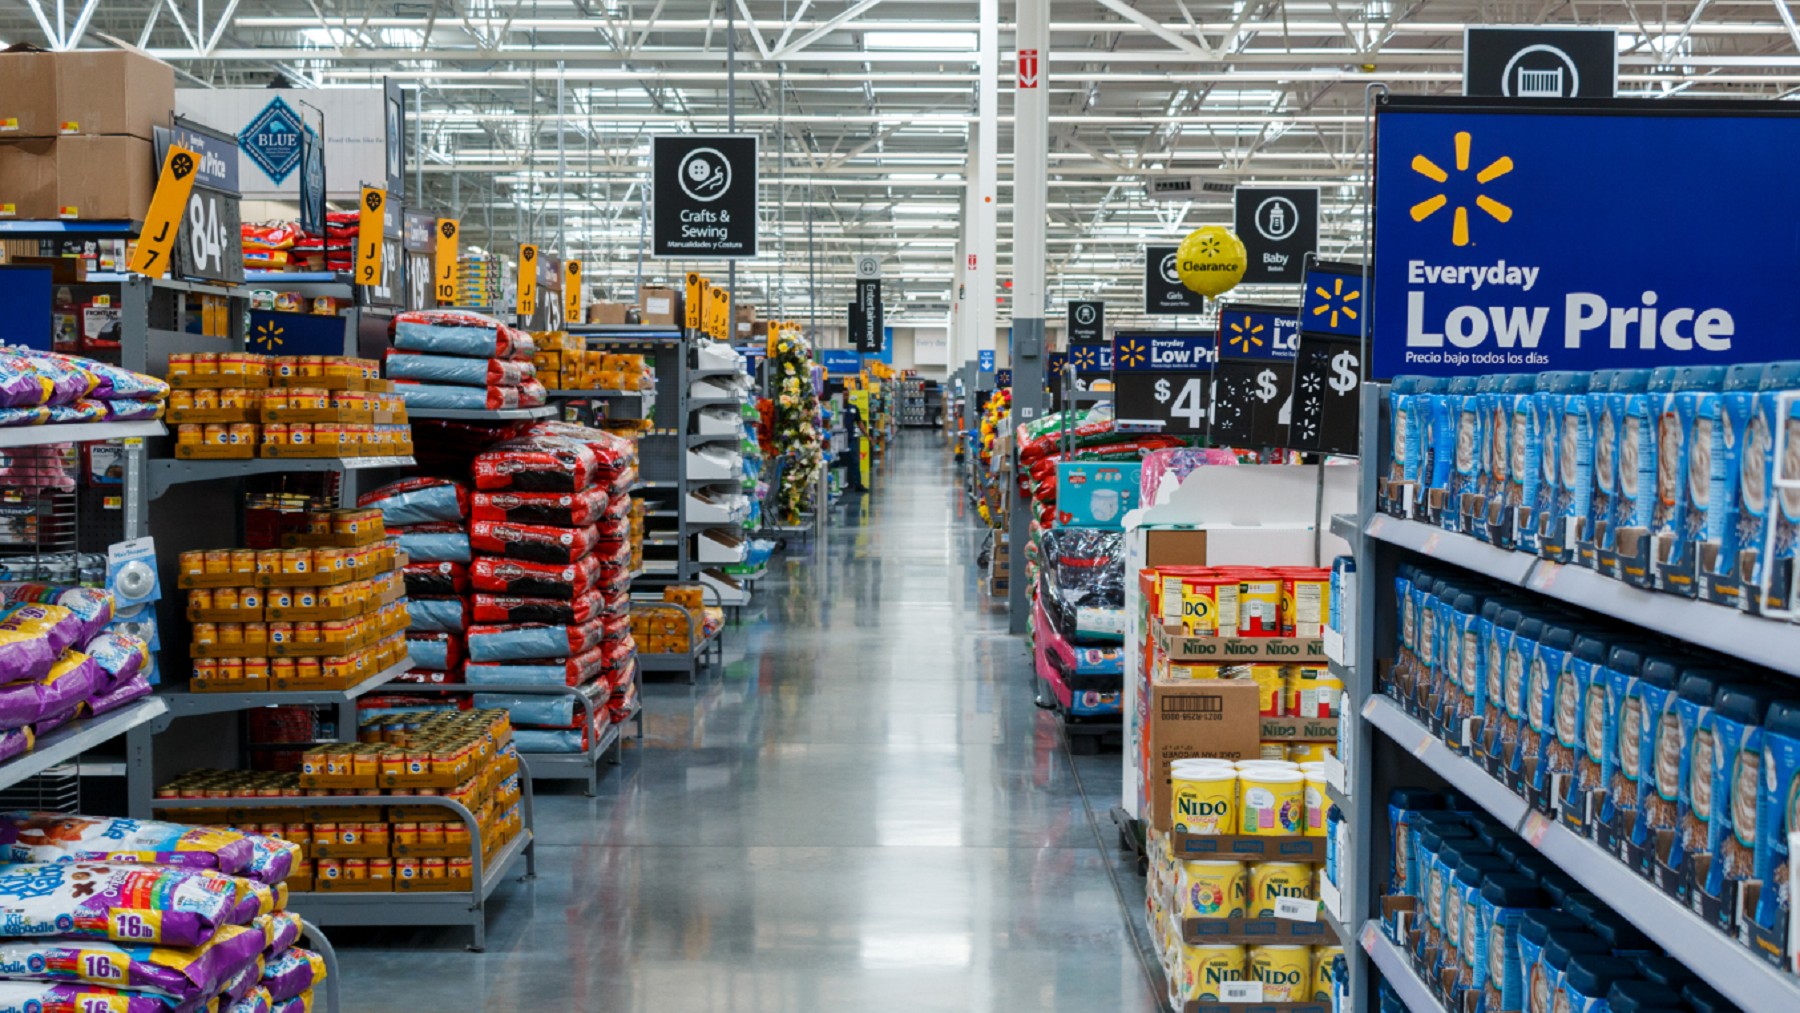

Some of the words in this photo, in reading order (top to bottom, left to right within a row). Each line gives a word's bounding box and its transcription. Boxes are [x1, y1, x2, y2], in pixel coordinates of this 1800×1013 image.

[259, 134, 297, 146] BLUE
[680, 209, 717, 222] Crafts
[720, 209, 730, 222] &
[153, 222, 169, 242] J
[681, 225, 728, 241] Sewing
[366, 243, 375, 259] J
[143, 250, 160, 270] 7
[1263, 252, 1289, 265] Baby
[364, 265, 374, 281] 9
[443, 265, 451, 279] J
[1183, 261, 1238, 272] Clearance
[1408, 259, 1540, 291] Everyday
[439, 284, 453, 297] 10
[524, 284, 530, 296] J
[1166, 291, 1183, 300] Girls
[522, 301, 531, 312] 11
[570, 294, 577, 306] J
[568, 310, 578, 320] 12
[691, 304, 696, 313] J
[688, 317, 698, 326] 13
[866, 284, 876, 348] Entertainment
[1406, 290, 1550, 348] Low
[1563, 290, 1735, 351] Price
[1151, 339, 1185, 348] Everyday
[1151, 347, 1191, 363] Low
[1406, 351, 1442, 364] Precio
[1444, 351, 1470, 366] bajo
[1472, 352, 1505, 364] todos
[1507, 352, 1523, 364] los
[1525, 352, 1549, 364] días
[1329, 350, 1359, 396] $
[1183, 643, 1217, 655] NIDO
[1224, 643, 1259, 655] NIDO
[1266, 643, 1300, 655] NIDO
[1263, 723, 1297, 736] NIDO
[1304, 723, 1337, 736] NIDO
[1178, 797, 1227, 816] NIDO
[6, 914, 21, 925] Kit
[3, 921, 55, 935] Kaboodle
[1252, 965, 1300, 985] NIDO
